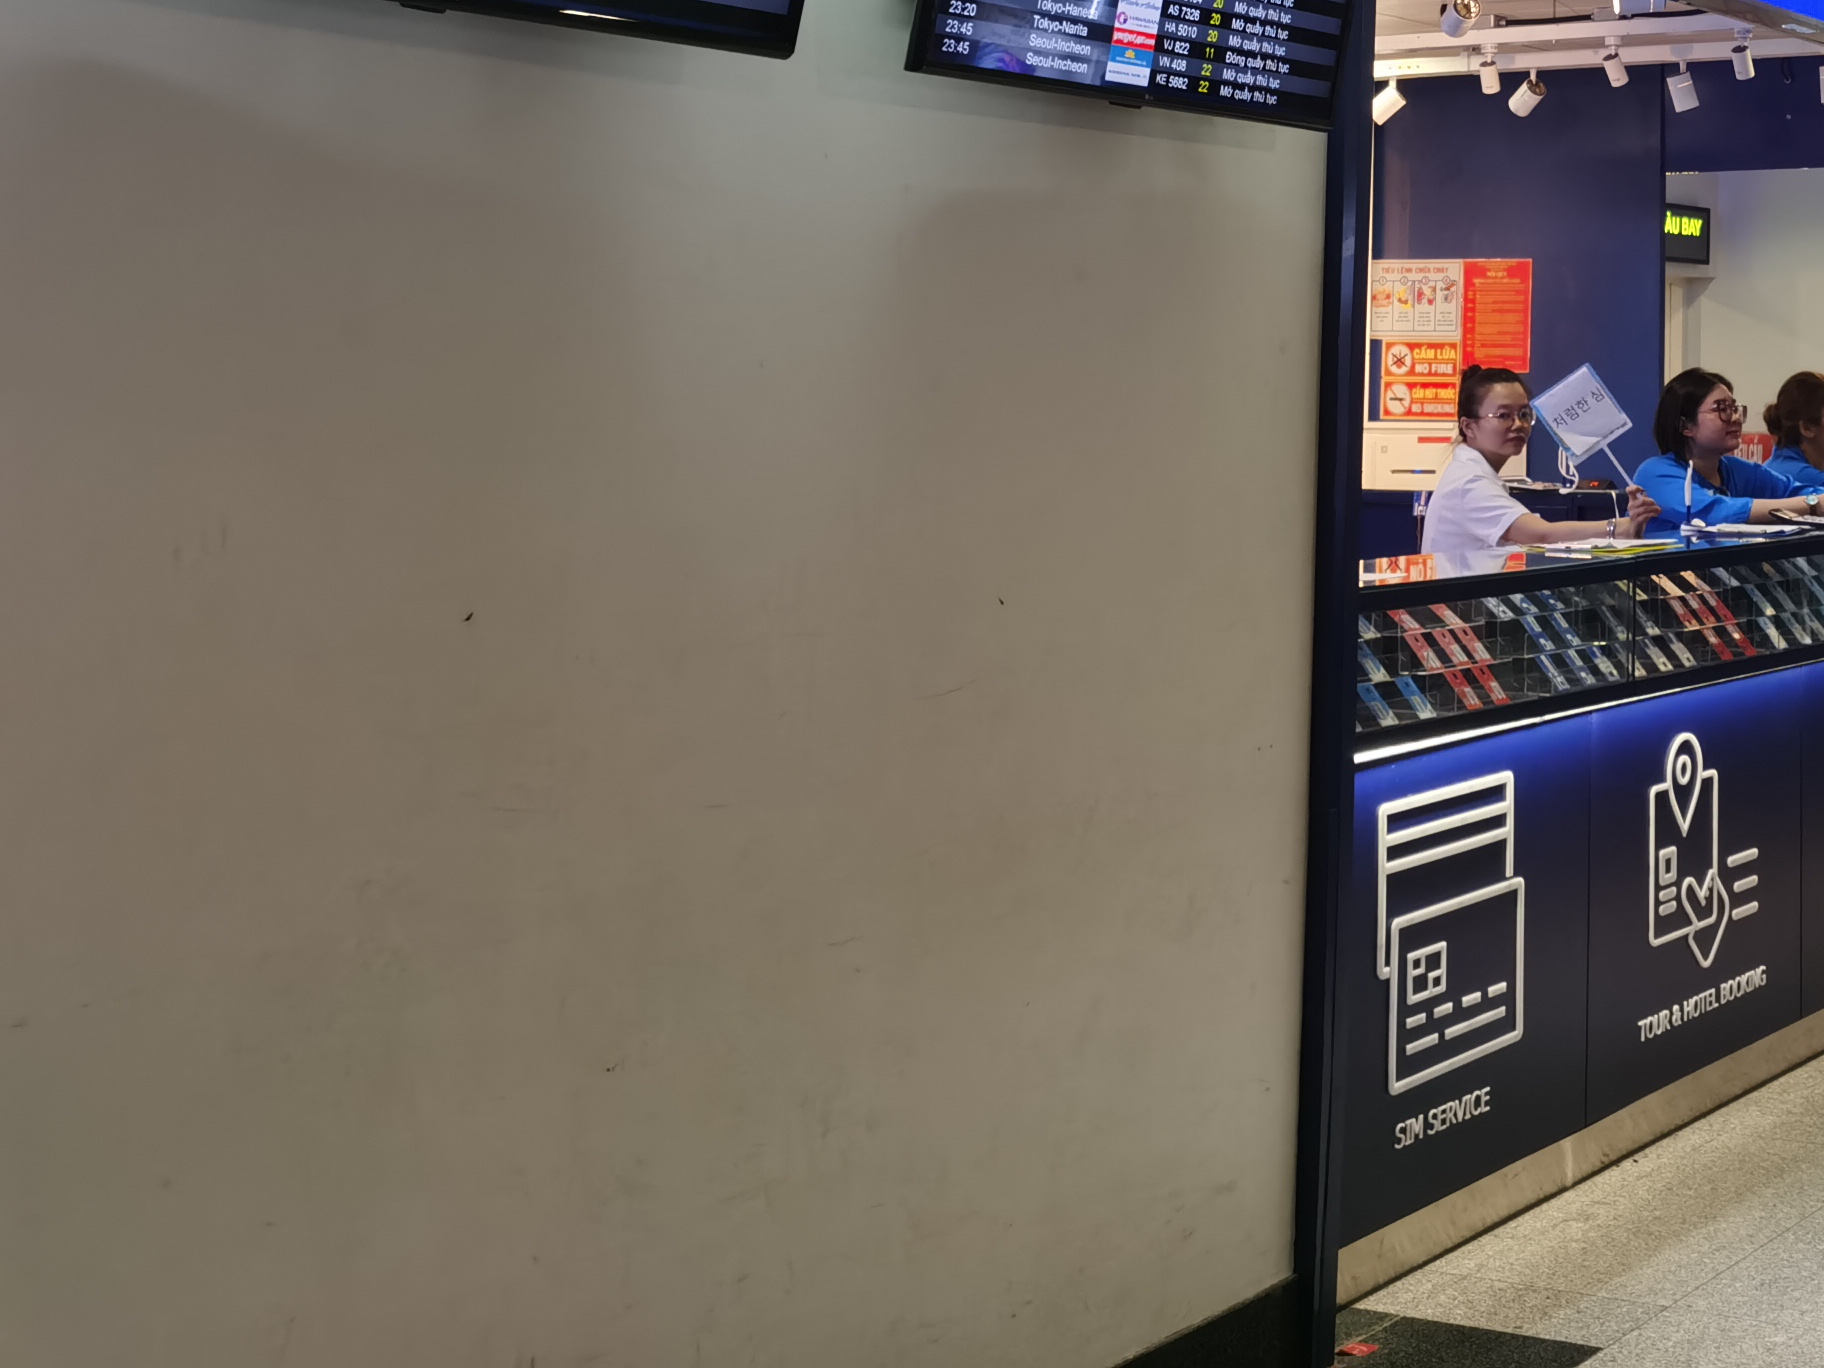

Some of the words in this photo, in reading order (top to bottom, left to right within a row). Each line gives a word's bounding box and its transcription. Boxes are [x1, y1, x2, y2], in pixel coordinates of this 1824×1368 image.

[949, 0, 976, 16] 23:20
[1034, 15, 1087, 36] Tokyo-Narita
[1164, 39, 1173, 50] VJ
[1175, 41, 1189, 54] 822
[1664, 210, 1680, 235] ÀU
[1681, 217, 1703, 237] BAY
[1413, 346, 1435, 360] CẤM
[1437, 345, 1456, 359] LỬA
[1414, 363, 1430, 374] NO
[1432, 363, 1454, 374] FIRE
[1411, 403, 1422, 413] NO
[1423, 403, 1455, 413] SMOKING
[1637, 1009, 1671, 1042] TOUR
[1672, 1004, 1682, 1027] &
[1683, 987, 1719, 1021] HOTEL
[1720, 965, 1767, 1005] BOOKING
[1394, 1114, 1424, 1149] SIM
[1427, 1086, 1491, 1135] SERVICE
